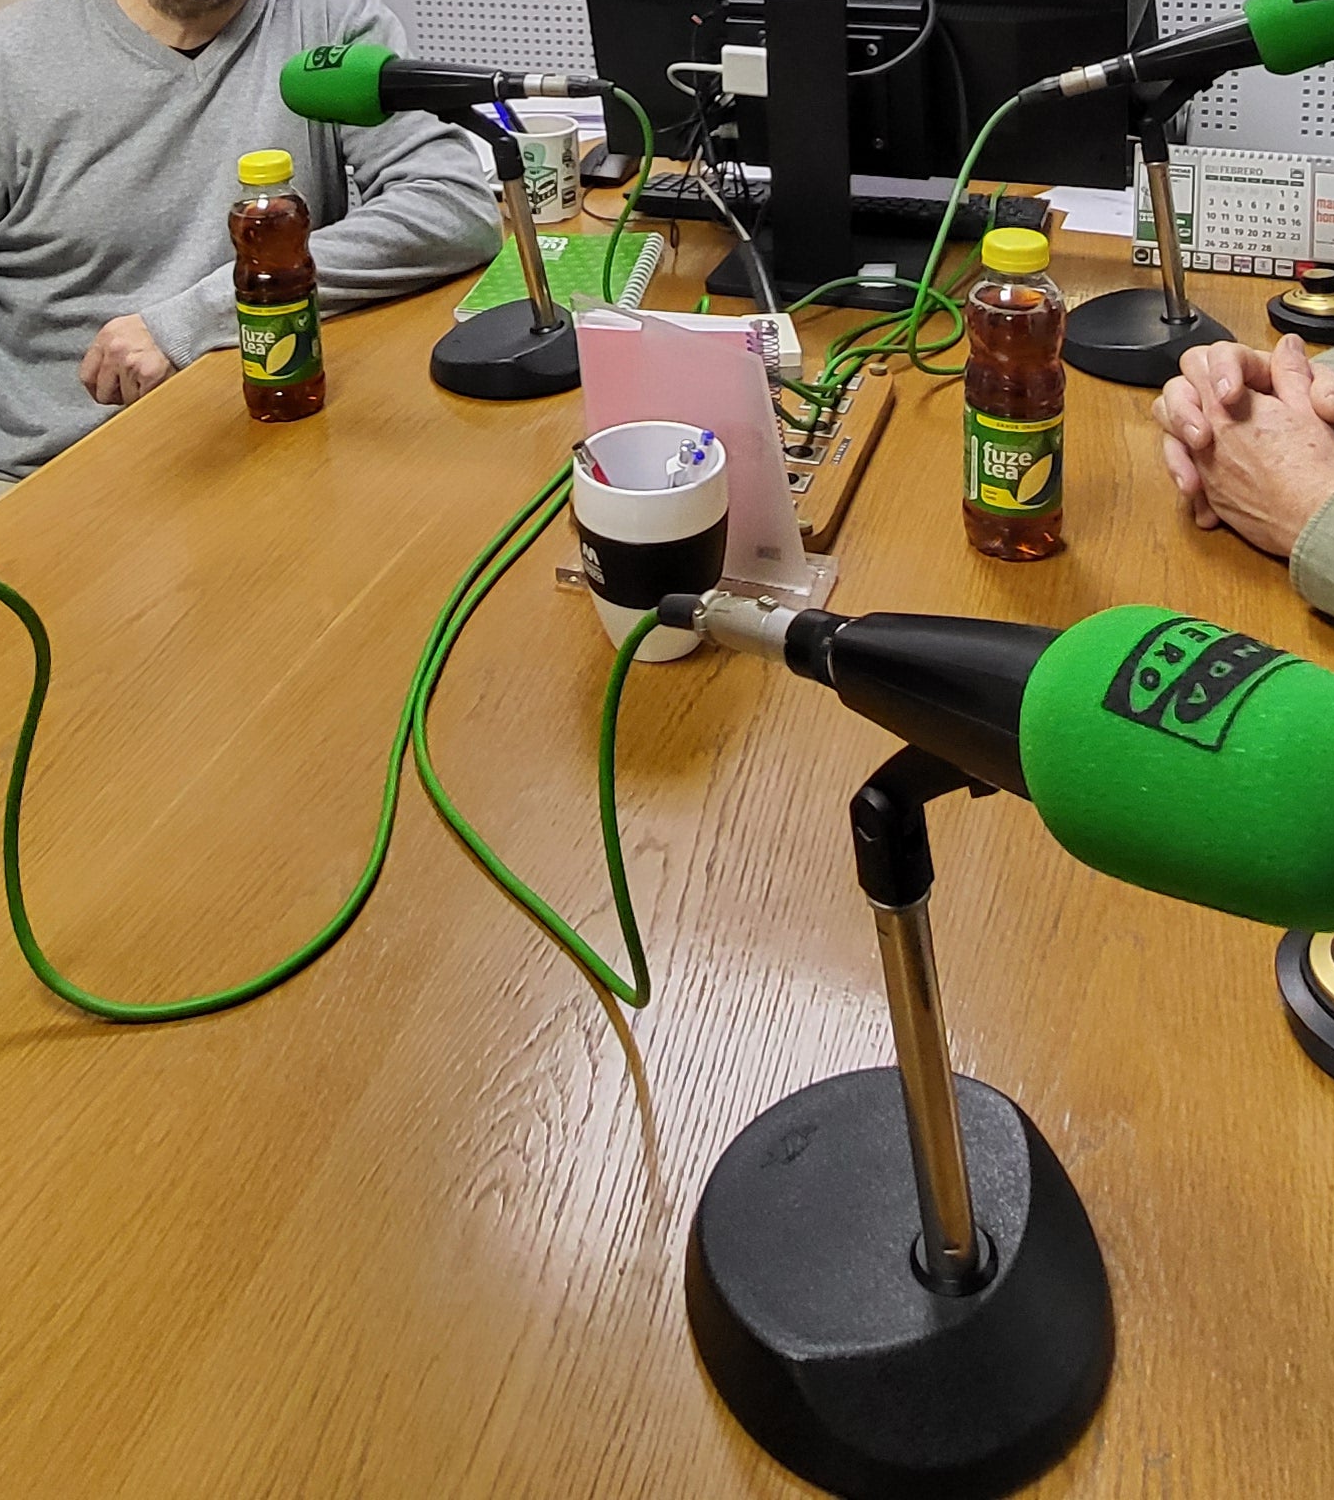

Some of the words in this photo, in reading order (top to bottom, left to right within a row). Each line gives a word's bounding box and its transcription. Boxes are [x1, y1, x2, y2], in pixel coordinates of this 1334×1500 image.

[1220, 166, 1263, 176] FEBRERO
[1237, 200, 1242, 208] 5
[1251, 201, 1256, 209] 6
[1235, 214, 1244, 222] 12
[1247, 229, 1258, 237] 20
[1262, 230, 1271, 238] 21
[1276, 231, 1286, 239] 22
[1233, 242, 1244, 250] 26
[1248, 243, 1257, 251] 27
[241, 324, 275, 343] fuze
[243, 341, 266, 355] tea
[983, 441, 1033, 466] fuze
[983, 459, 1019, 480] tea
[1139, 624, 1230, 691] ERO
[1187, 644, 1261, 704] NDA
